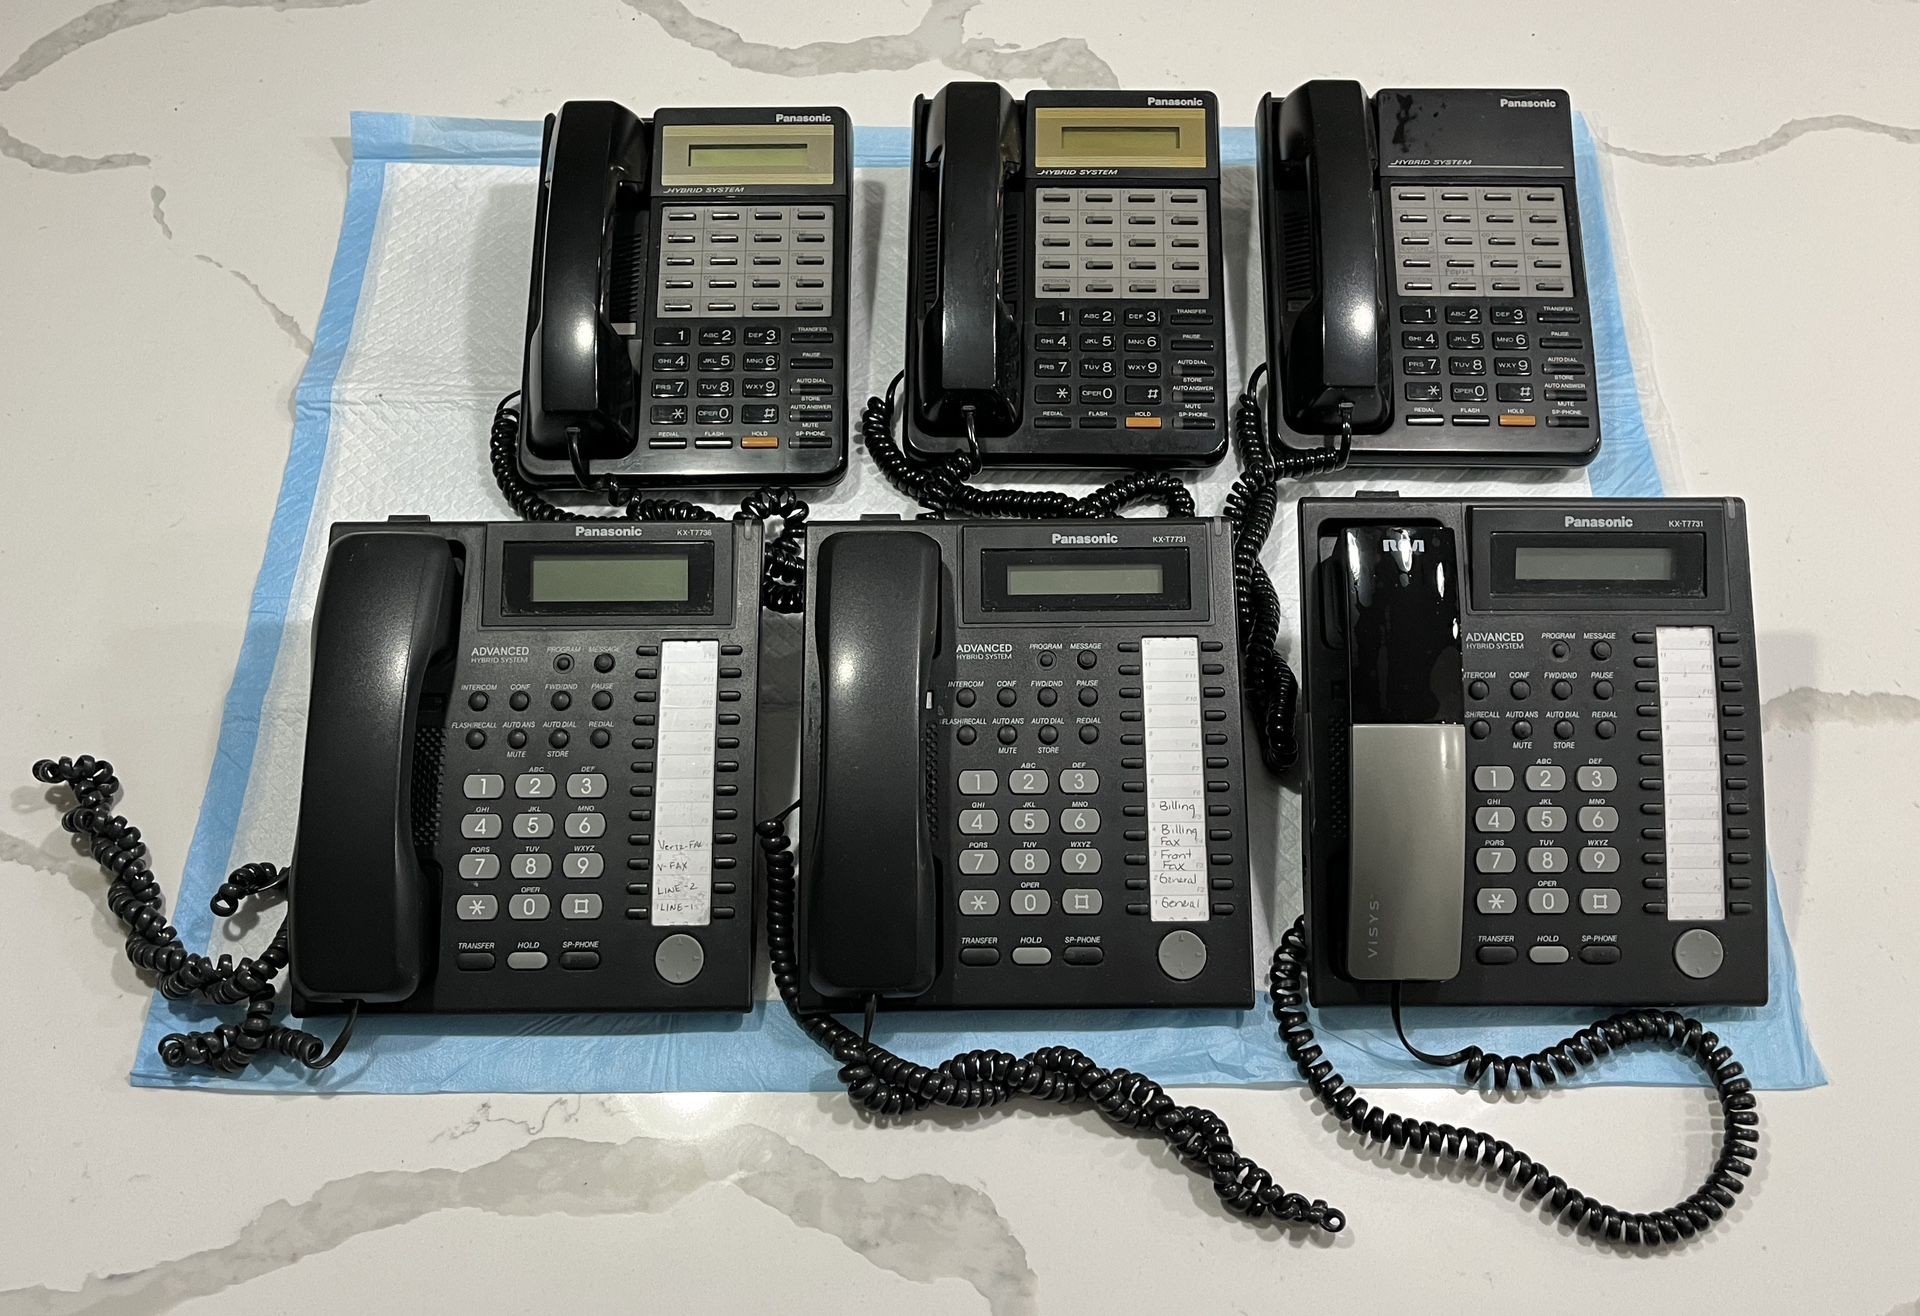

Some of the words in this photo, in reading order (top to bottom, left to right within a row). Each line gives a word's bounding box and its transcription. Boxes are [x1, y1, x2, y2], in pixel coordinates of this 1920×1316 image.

[1148, 97, 1203, 106] Panasonic
[1500, 99, 1556, 107] Panasonic
[776, 114, 831, 122] Panasonic
[1564, 516, 1633, 528] Panasonic
[1669, 520, 1704, 528] KX-T7731
[575, 526, 642, 537] Panasonic
[1052, 533, 1118, 544] Panasonic
[1466, 632, 1524, 642] ADVANCED
[471, 646, 529, 656] ADVANCED
[956, 644, 1012, 653] ADVANCED
[529, 778, 541, 794] 2
[581, 778, 592, 794] 3
[974, 774, 981, 790] 1
[1023, 774, 1034, 790] 2
[1074, 774, 1084, 789] 3
[1491, 771, 1496, 787] 1
[1540, 770, 1551, 786] 2
[1592, 771, 1603, 786] 3
[480, 779, 486, 795] 1
[1160, 800, 1195, 819] Billing
[474, 818, 486, 834] 4
[527, 818, 538, 833] 5
[579, 818, 590, 834] 6
[971, 814, 983, 830] 4
[1024, 814, 1035, 829] 5
[1074, 813, 1086, 829] 6
[1488, 811, 1500, 828] 4
[1541, 812, 1552, 828] 5
[1593, 812, 1604, 827] 6
[1161, 824, 1198, 841] Billing
[1160, 836, 1180, 846] Fax
[974, 854, 984, 870] 7
[1024, 854, 1035, 870] 8
[1075, 854, 1087, 870] 9
[1160, 849, 1191, 859] Front
[1490, 852, 1502, 868] 7
[1542, 852, 1554, 868] 8
[1594, 852, 1606, 868] 9
[475, 859, 486, 875] 7
[525, 858, 536, 874] 8
[578, 858, 589, 874] 9
[1163, 861, 1185, 871] Fax
[1160, 873, 1196, 884] General
[523, 899, 535, 915] 0
[1024, 895, 1036, 911] 0
[1542, 893, 1554, 909] 0
[1368, 901, 1379, 958] VISYS
[1020, 936, 1042, 944] HOLD
